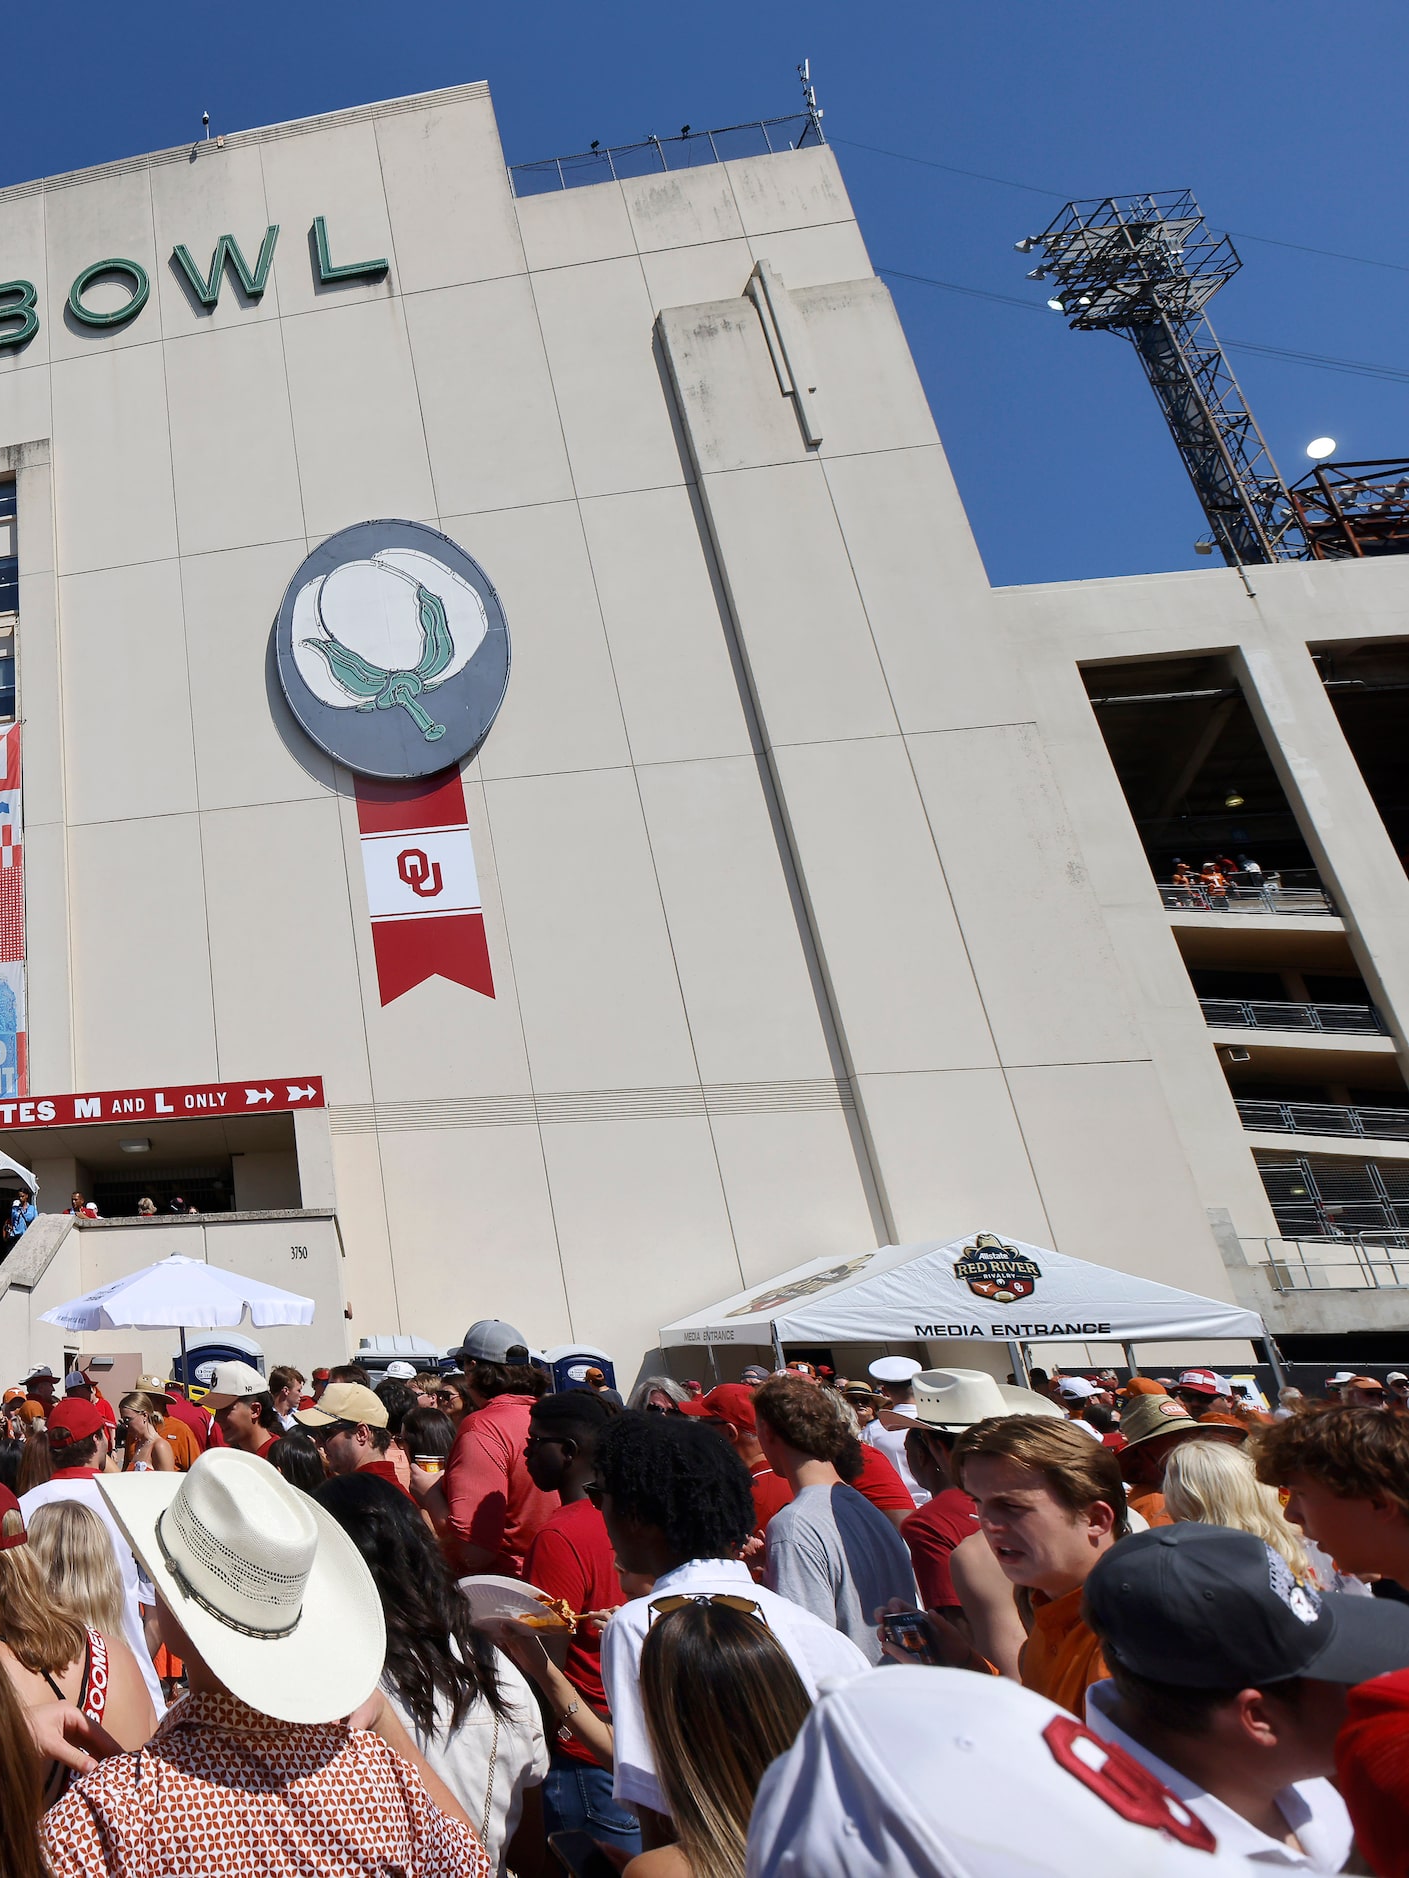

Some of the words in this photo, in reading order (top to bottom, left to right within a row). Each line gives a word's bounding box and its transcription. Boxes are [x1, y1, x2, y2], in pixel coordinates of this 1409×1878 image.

[396, 848, 443, 897] OU
[74, 1098, 102, 1118] M
[111, 1098, 145, 1114] AND
[155, 1092, 174, 1113] L
[184, 1092, 227, 1109] ONLY
[290, 1246, 308, 1260] 3750
[978, 1252, 1009, 1260] Allstate
[958, 1262, 987, 1276] RED
[989, 1261, 1039, 1275] RIVER
[684, 1332, 701, 1341] MEDIA
[703, 1331, 734, 1341] ENTRANCE
[914, 1324, 984, 1336] MEDIA
[991, 1323, 1111, 1336] ENTRANCE
